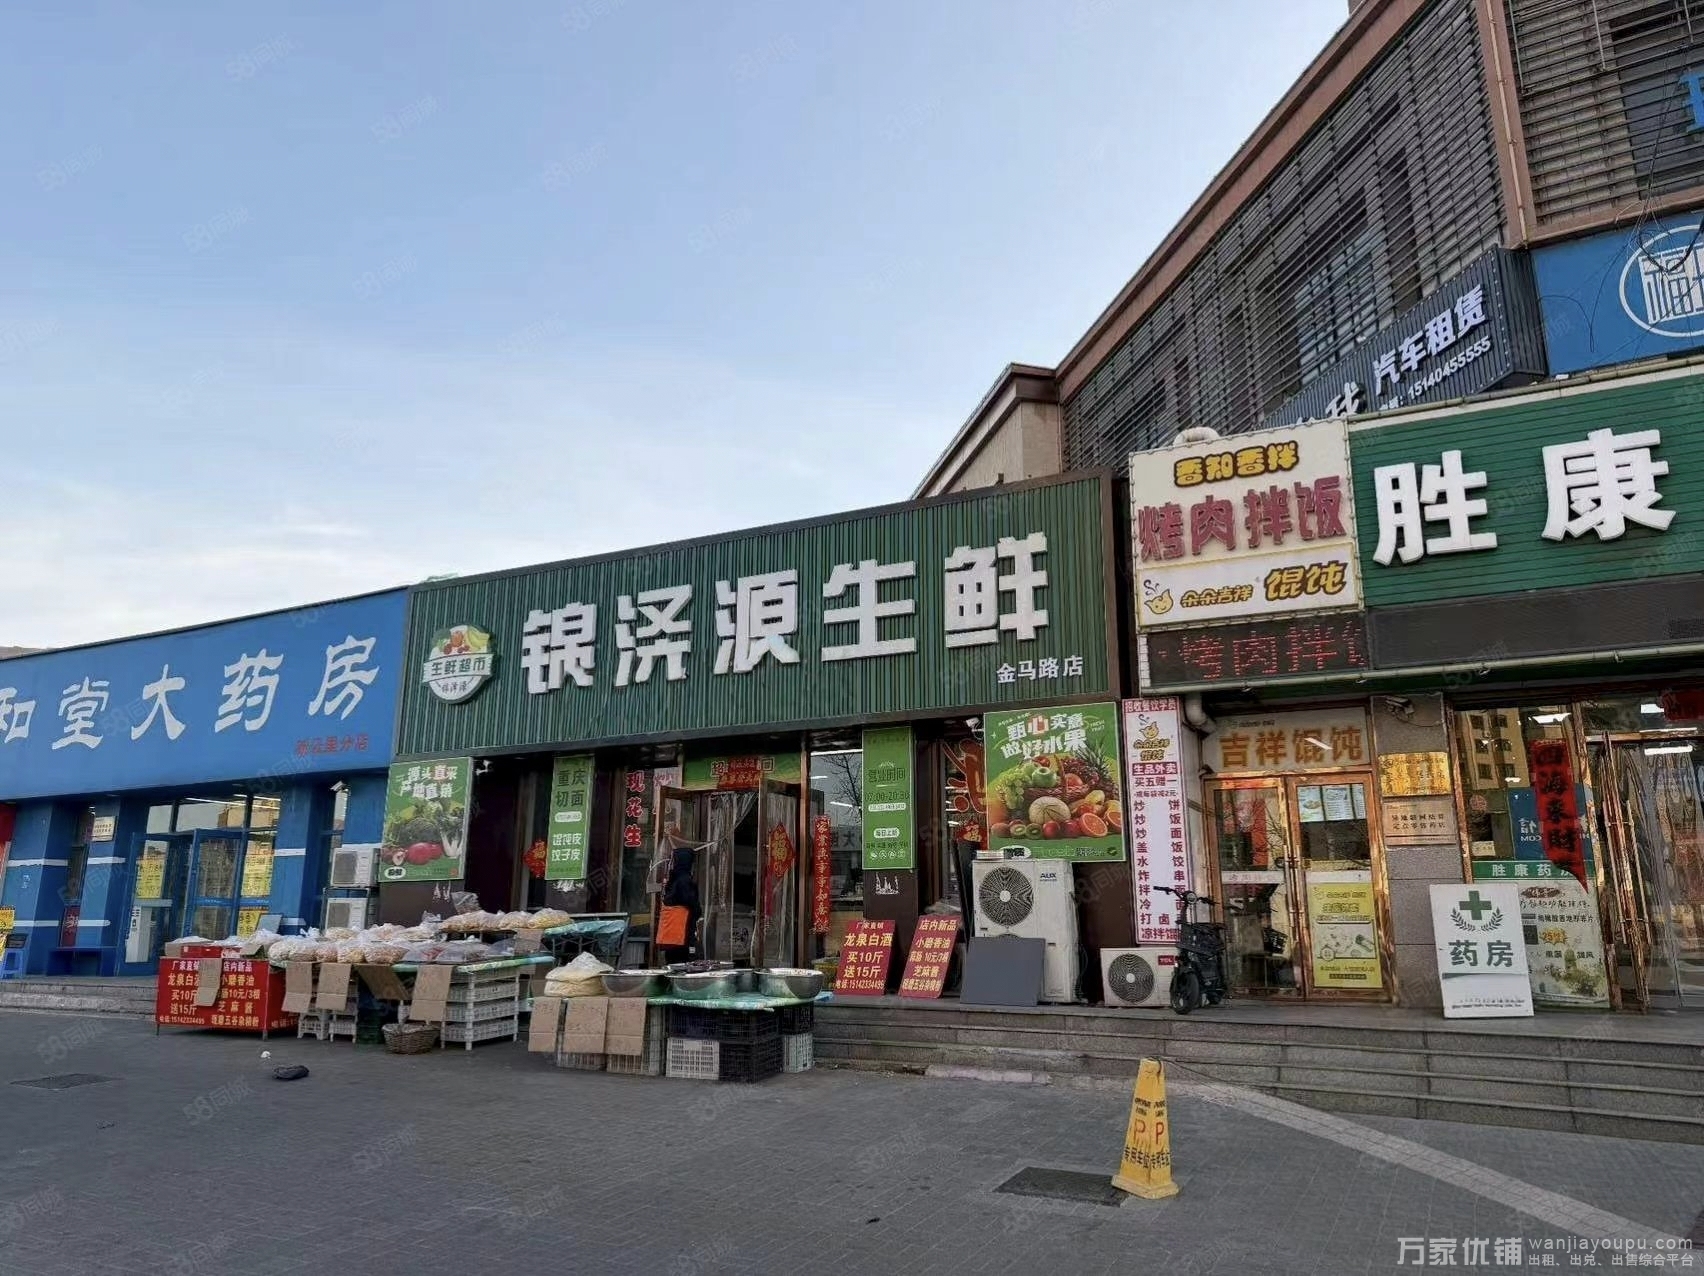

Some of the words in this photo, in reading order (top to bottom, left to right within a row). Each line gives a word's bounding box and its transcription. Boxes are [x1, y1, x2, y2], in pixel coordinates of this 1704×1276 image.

[1372, 283, 1486, 396] 汽车租赁
[1407, 335, 1491, 400] 15140455555
[1372, 427, 1677, 566] 胜康
[1138, 476, 1347, 562] 烤肉拌饭
[1264, 560, 1348, 601] 馄饨
[431, 657, 486, 676] 生鲜超市
[996, 655, 1083, 684] 金马路店
[1001, 728, 1088, 760] 做好水果
[1219, 725, 1364, 768] 吉祥馄饨
[557, 770, 586, 787] 重庆
[1134, 776, 1177, 787] 买五赠一
[555, 790, 584, 808] 切面
[919, 920, 958, 931] 店内新品
[843, 933, 893, 947] 龙泉白酒
[915, 937, 951, 949] 小磨香油
[846, 951, 884, 964] 买10斤
[1448, 939, 1514, 968] 药房
[223, 962, 253, 972] 店内新品
[843, 965, 881, 978] 送15斤
[912, 965, 941, 978] 芝麻酱
[170, 1003, 197, 1015] 送15斤
[1133, 1118, 1146, 1144] P
[1156, 1121, 1165, 1145] P
